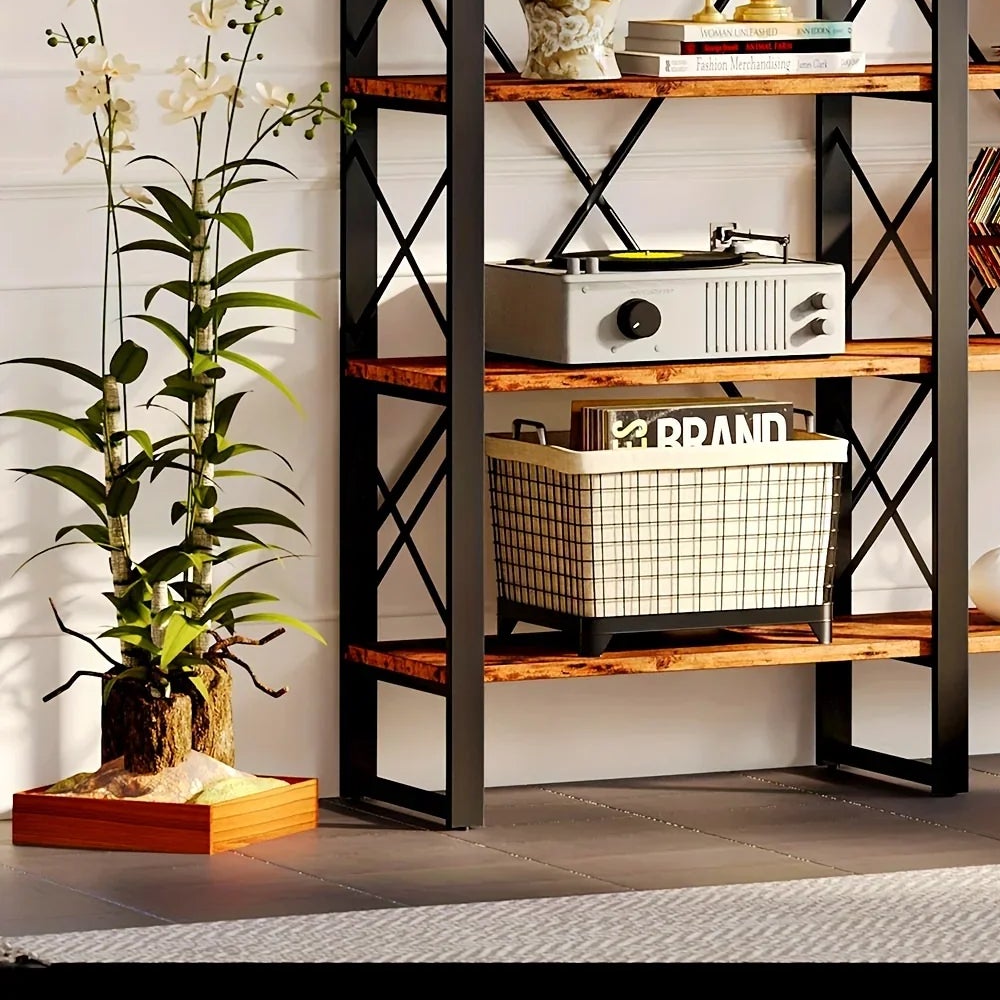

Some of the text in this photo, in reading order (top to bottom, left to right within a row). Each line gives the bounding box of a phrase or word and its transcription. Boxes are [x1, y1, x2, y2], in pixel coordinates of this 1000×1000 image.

[700, 27, 732, 38] WOMAN
[696, 56, 728, 71] Fashion
[730, 55, 790, 72] Merchandising
[656, 412, 788, 448] BRAND
